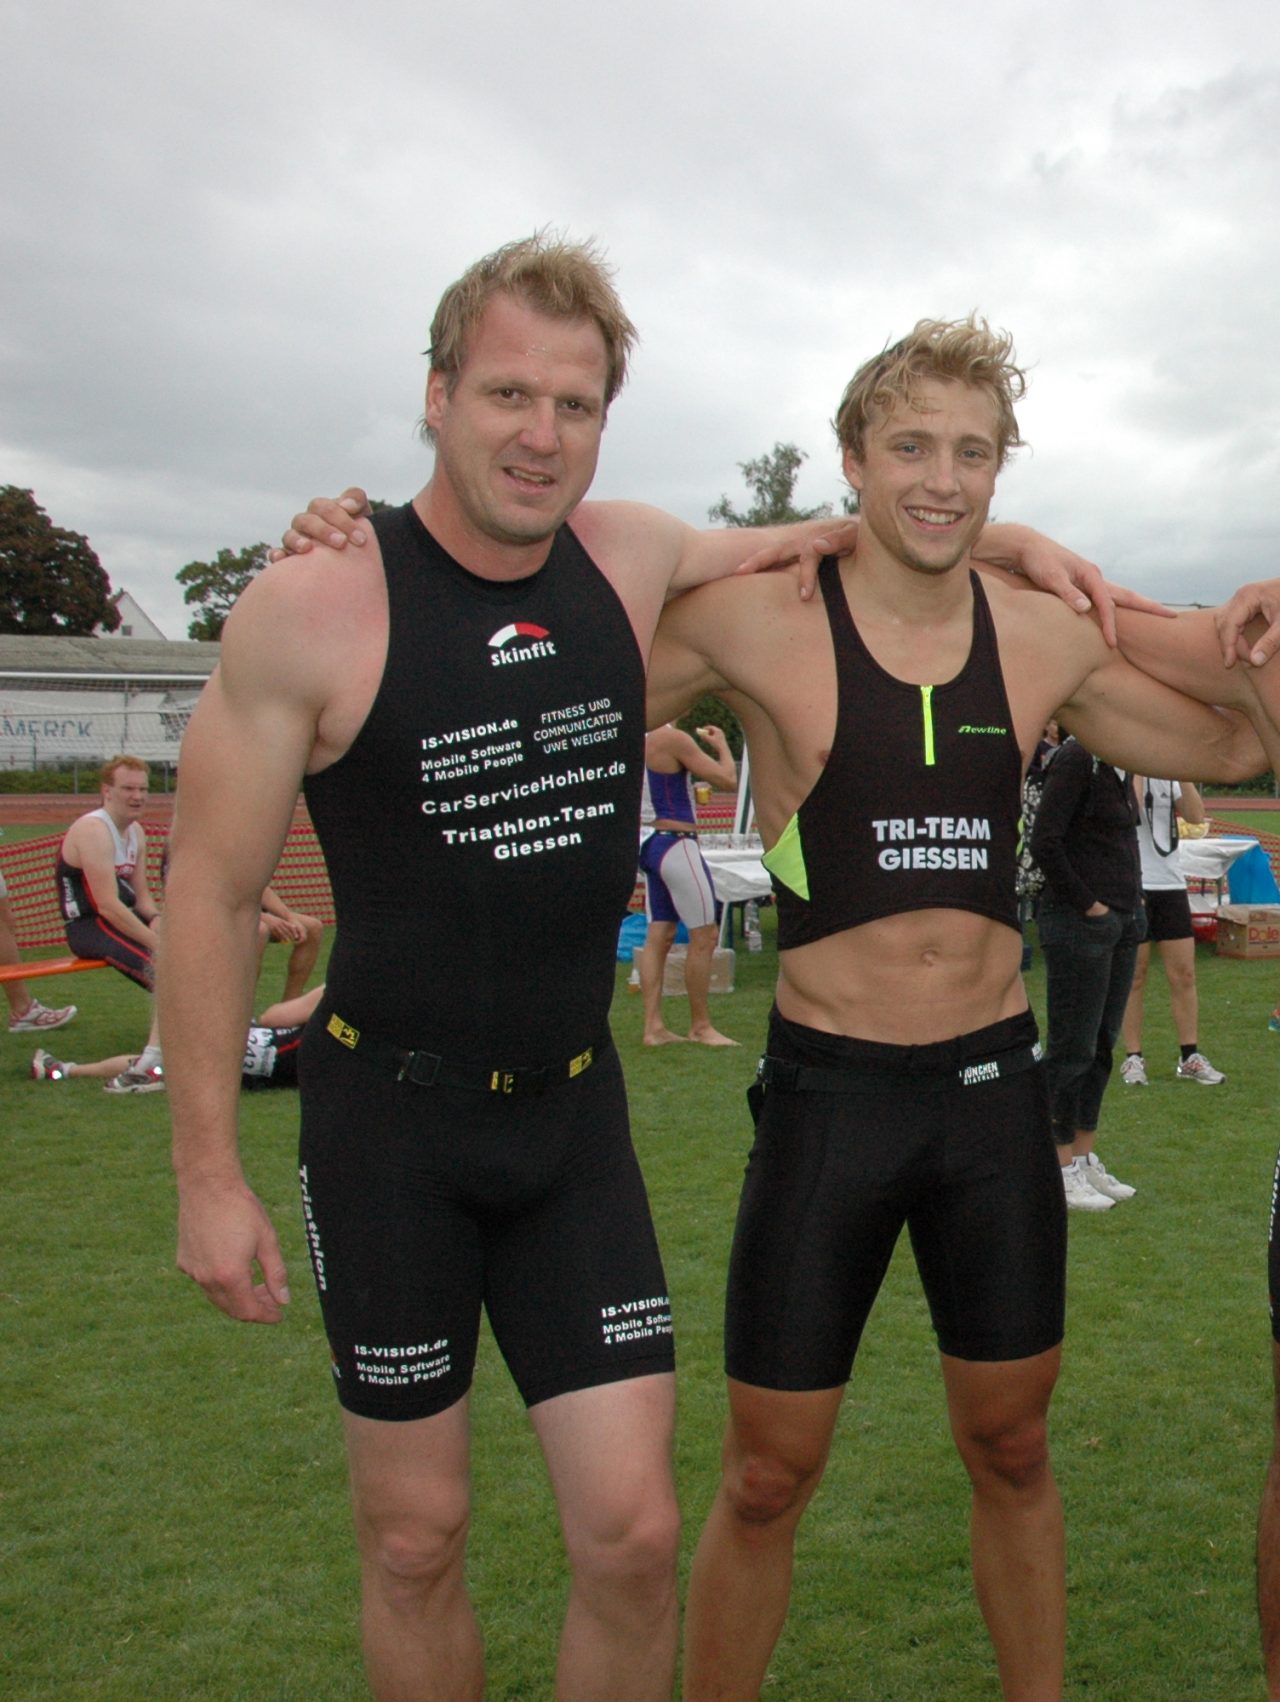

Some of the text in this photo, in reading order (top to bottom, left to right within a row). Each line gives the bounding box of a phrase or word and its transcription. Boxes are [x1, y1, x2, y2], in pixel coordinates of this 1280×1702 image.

[490, 641, 557, 667] skinfit
[541, 698, 611, 724] FITNESS UND
[421, 718, 518, 750] IS-VISION.de
[533, 711, 623, 742] COMMUNICATION
[543, 727, 619, 755] UWE WEIGERT
[421, 739, 522, 771] Mobile Software
[422, 752, 523, 783] 4 Mobile People
[421, 760, 626, 815] CarServiceHohler.de
[442, 802, 615, 845] Triathlon-Team
[872, 817, 991, 841] TRI-TEAM
[494, 831, 582, 860] Giessen
[878, 848, 988, 870] GIESSEN
[299, 1164, 327, 1291] Triathlon
[602, 1319, 643, 1335] Mobile
[604, 1335, 612, 1344] 4
[615, 1328, 653, 1342] Mobile
[354, 1339, 448, 1357] IS-VISION.de
[356, 1362, 395, 1374] Mobile
[400, 1354, 450, 1373] Software
[359, 1364, 451, 1385] 4 Mobile People
